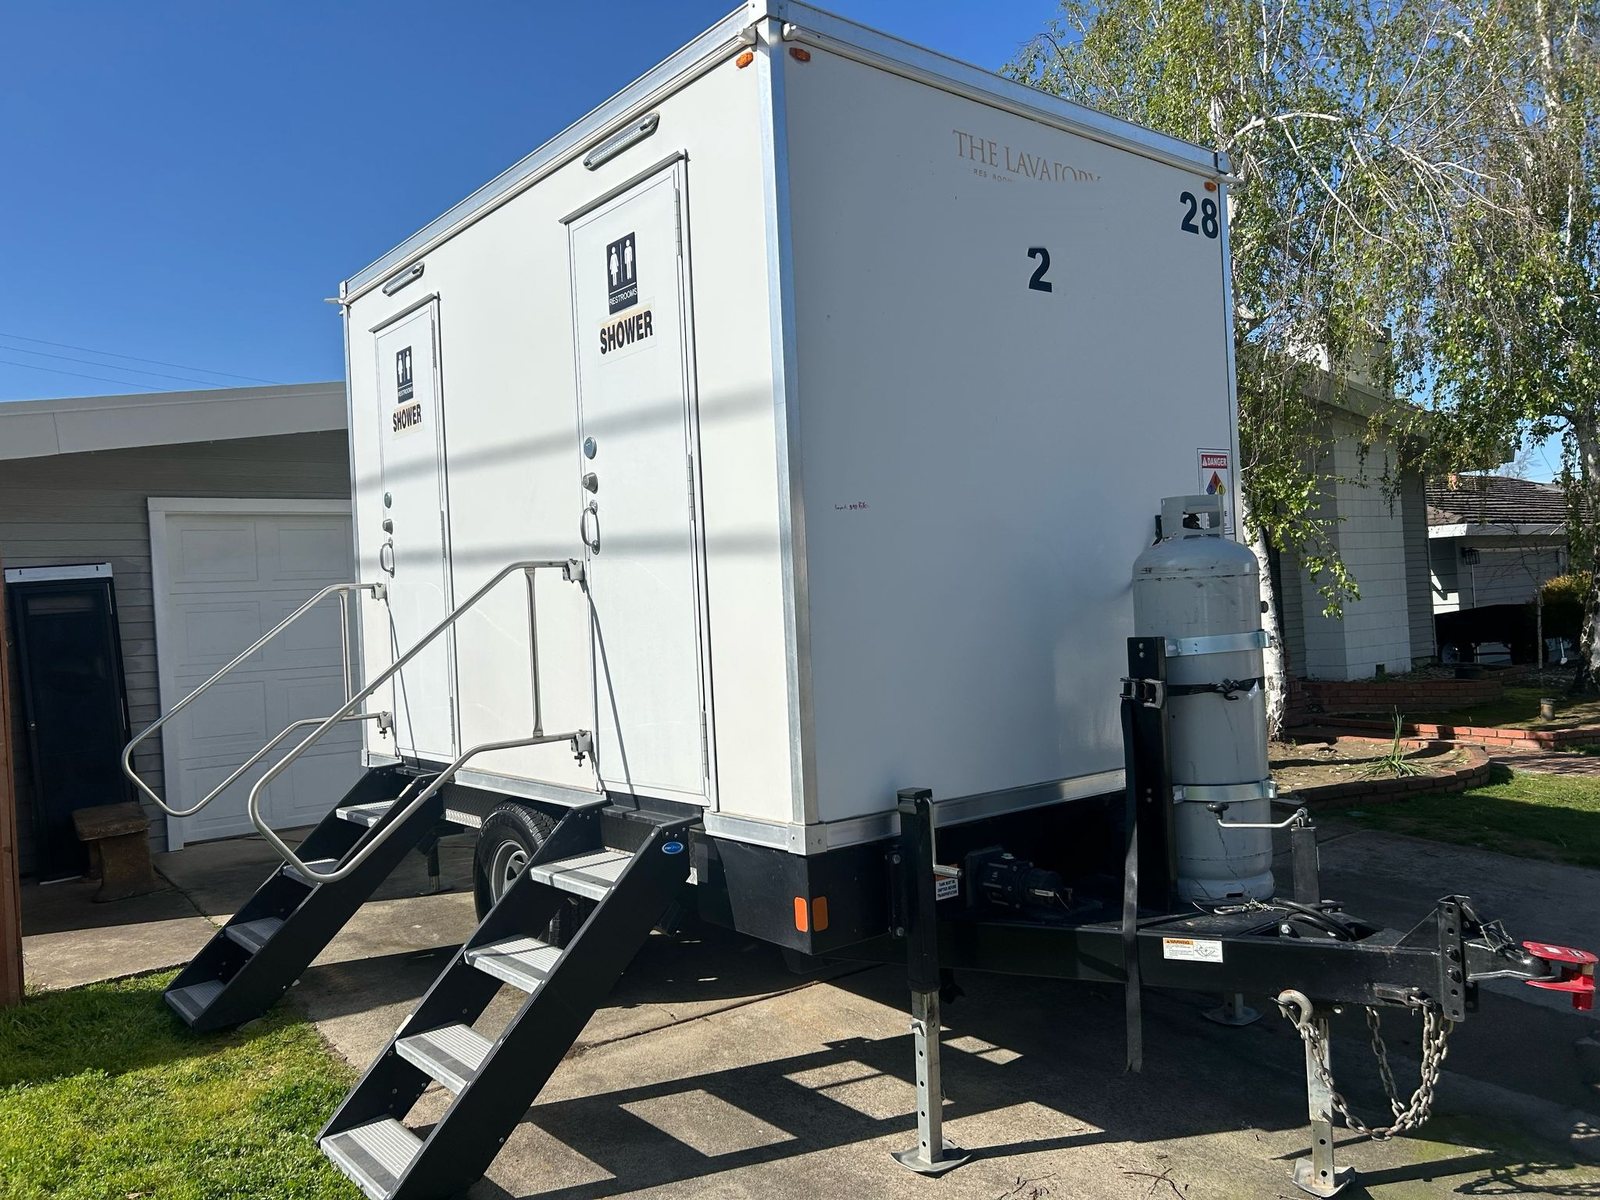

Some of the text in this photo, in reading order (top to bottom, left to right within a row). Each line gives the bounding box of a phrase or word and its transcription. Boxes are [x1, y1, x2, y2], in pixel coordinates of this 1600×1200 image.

[952, 129, 1101, 182] THE LAVATO
[1180, 191, 1219, 239] 28
[1027, 247, 1052, 293] 2
[609, 287, 638, 306] RESTROOMS
[600, 310, 654, 355] SHOWER
[392, 403, 422, 432] SHOWER
[1207, 457, 1227, 466] DANGER
